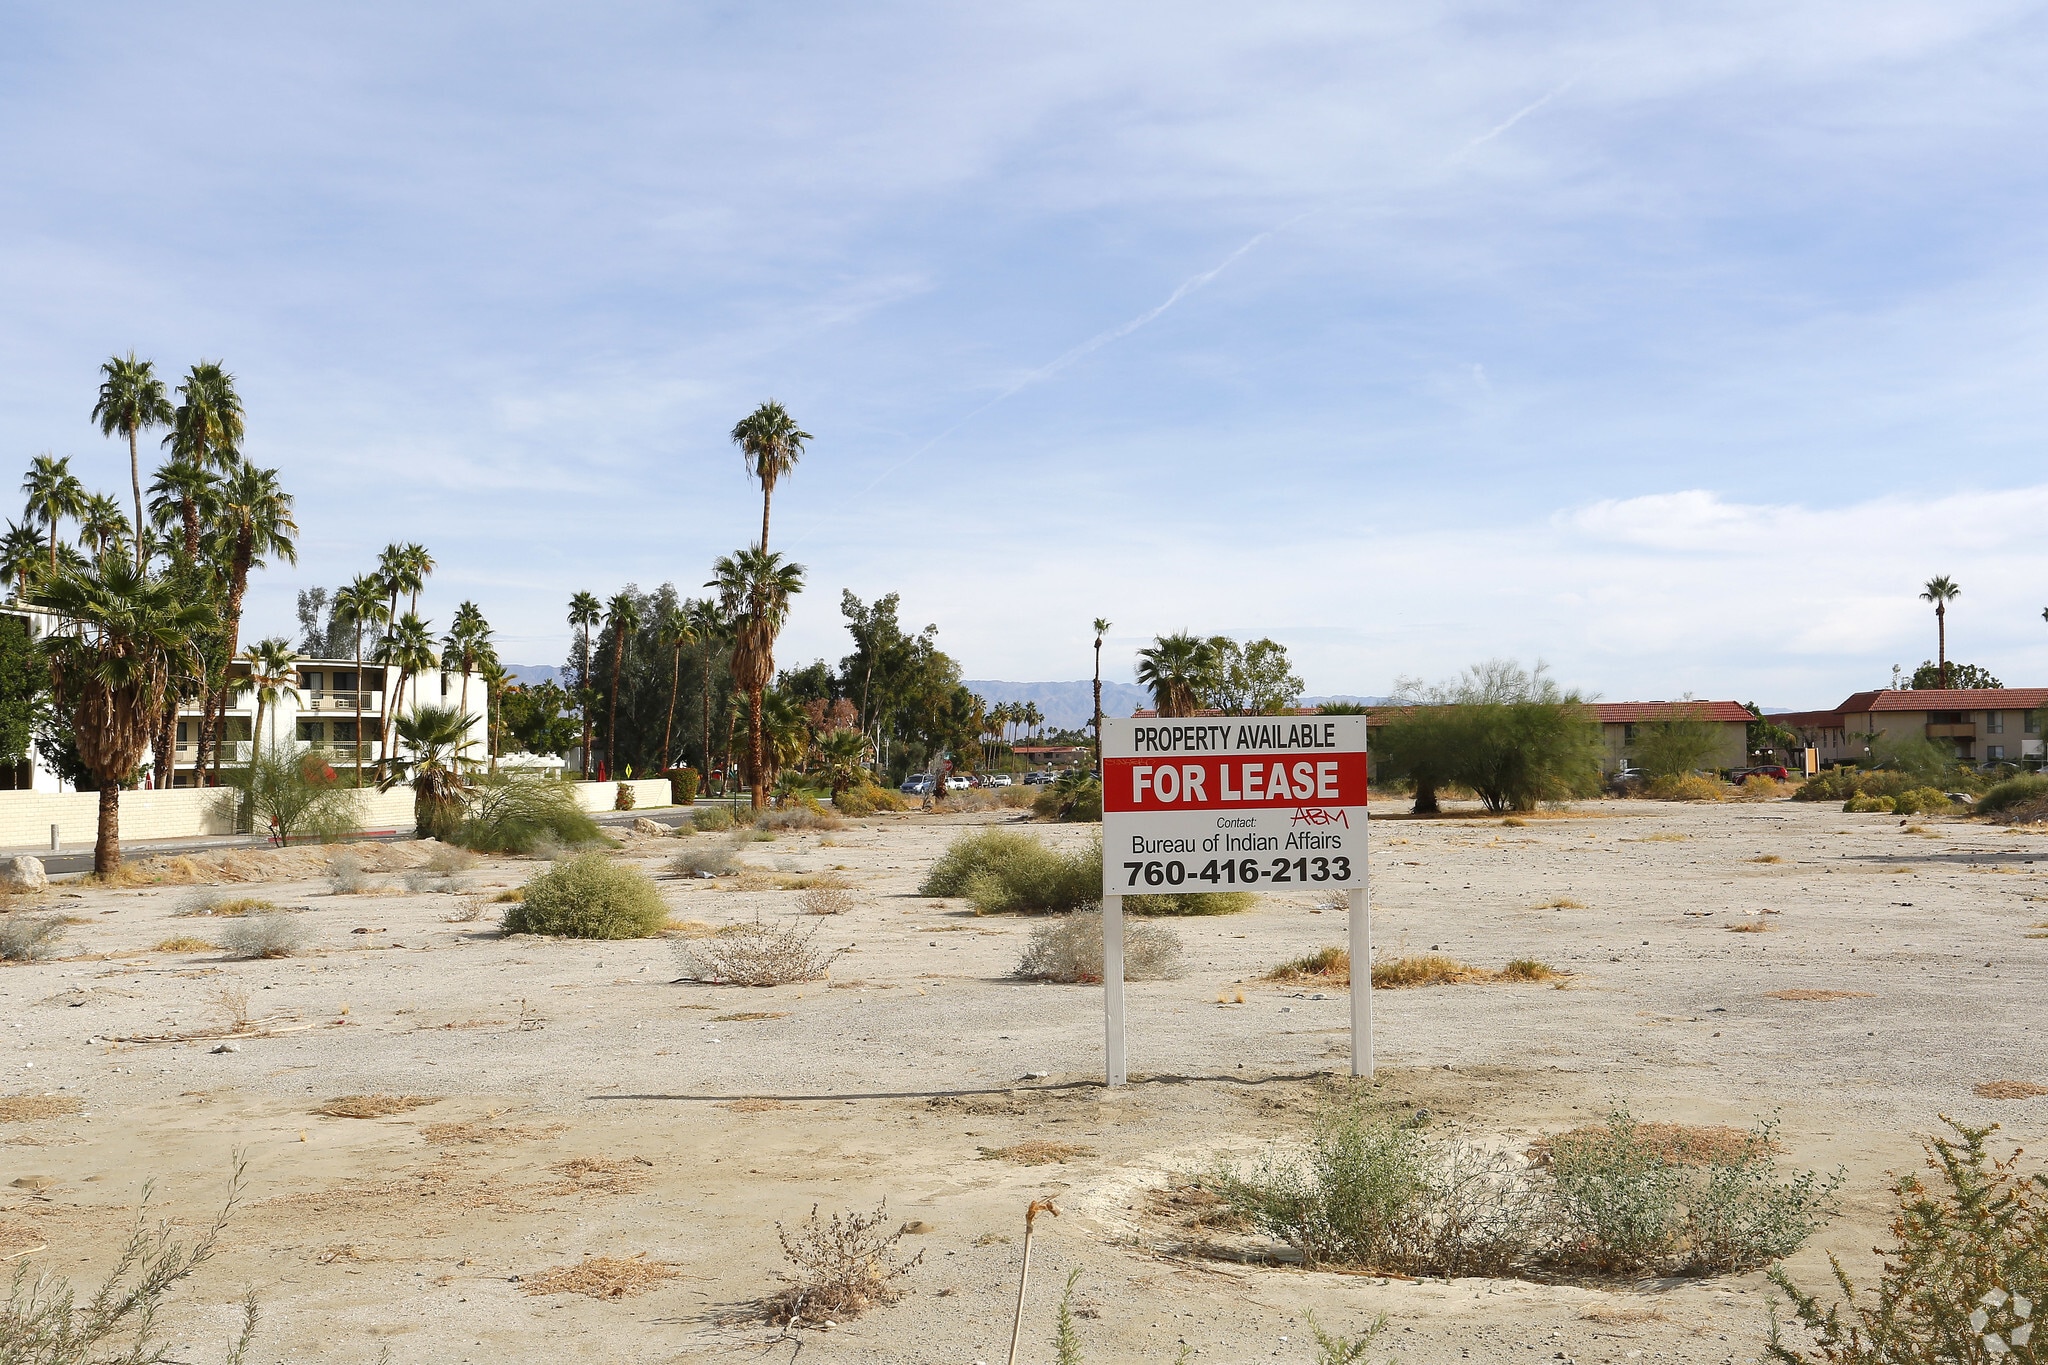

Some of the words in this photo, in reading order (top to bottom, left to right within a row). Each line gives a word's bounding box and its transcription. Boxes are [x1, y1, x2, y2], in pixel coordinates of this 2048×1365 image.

[1134, 725, 1232, 751] PROPERTY
[1236, 723, 1336, 749] AVAILABLE
[1132, 764, 1208, 803] FOR
[1220, 761, 1340, 801] LEASE
[1216, 817, 1257, 829] Contact:
[1290, 807, 1349, 829] ABM
[1132, 835, 1196, 854] Bureau
[1202, 833, 1220, 852] of
[1225, 833, 1279, 852] Indian
[1284, 831, 1342, 850] Affairs
[1123, 856, 1352, 887] 760-416-2133
